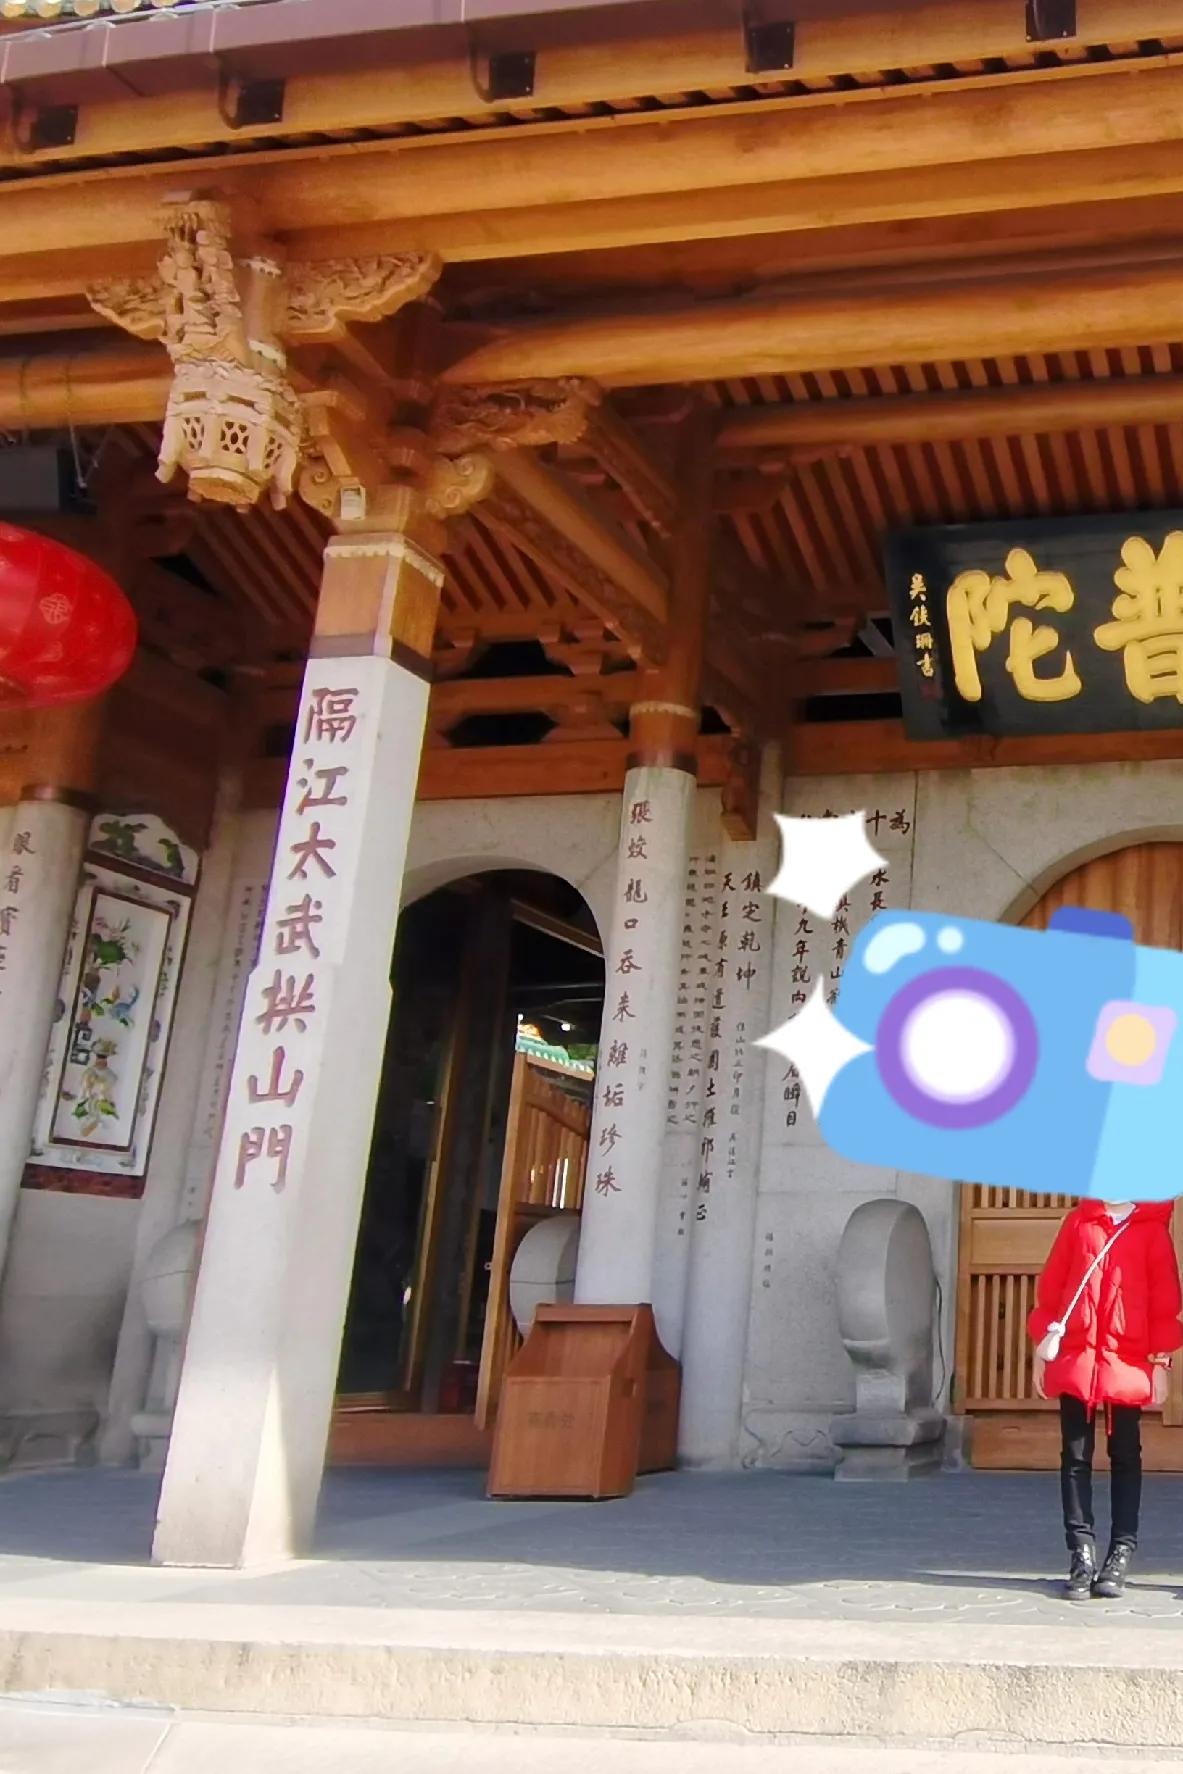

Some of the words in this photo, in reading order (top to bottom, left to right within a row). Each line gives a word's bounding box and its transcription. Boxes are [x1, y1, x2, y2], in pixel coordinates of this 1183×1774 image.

[233, 687, 360, 1196] 隔江太武拱山門
